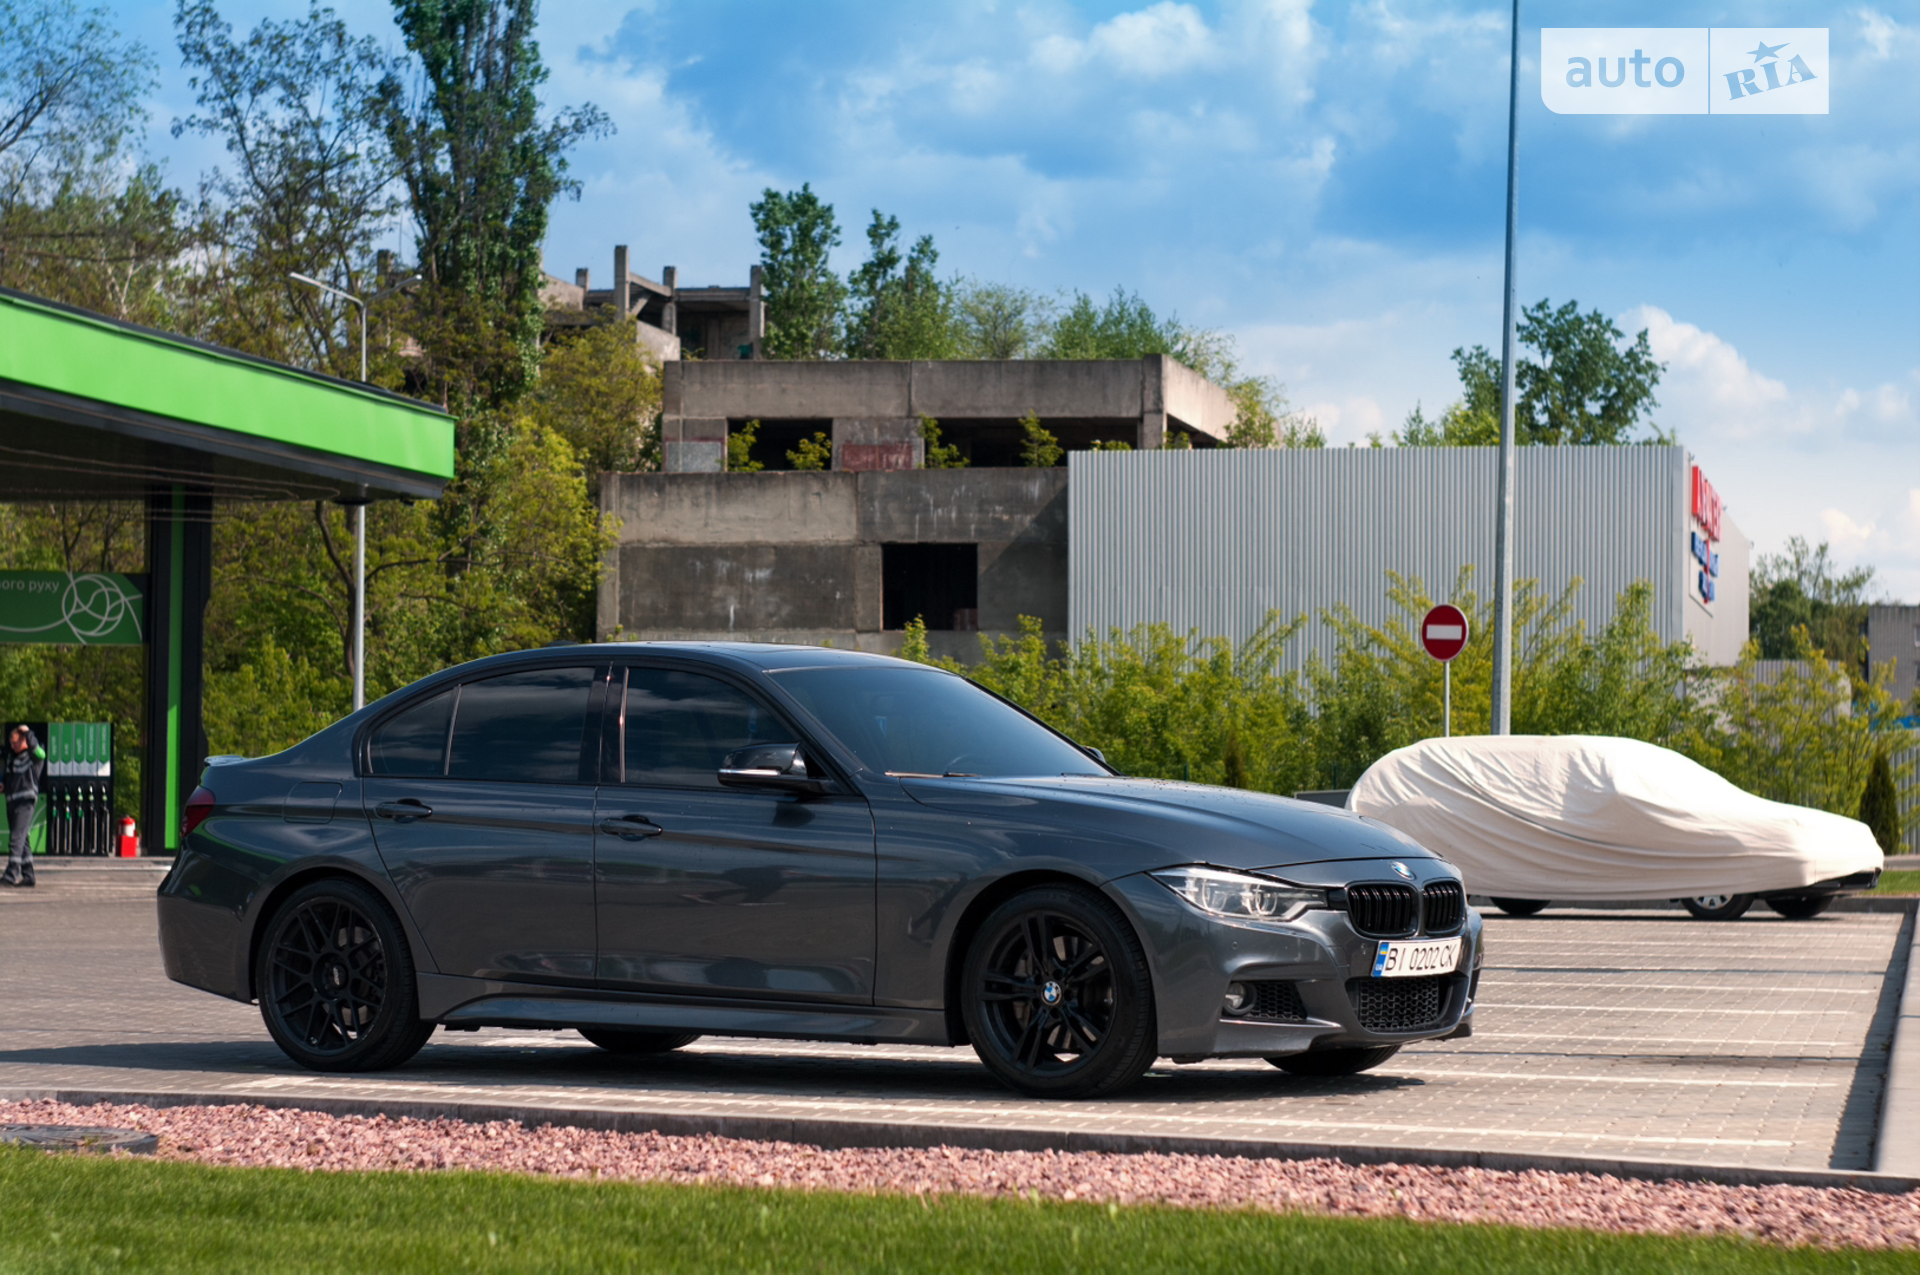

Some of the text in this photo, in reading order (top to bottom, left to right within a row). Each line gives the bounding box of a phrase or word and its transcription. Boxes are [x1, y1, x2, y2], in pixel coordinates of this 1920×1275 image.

[0, 579, 60, 594] ого руху
[1385, 944, 1457, 971] BI 0202 CK
